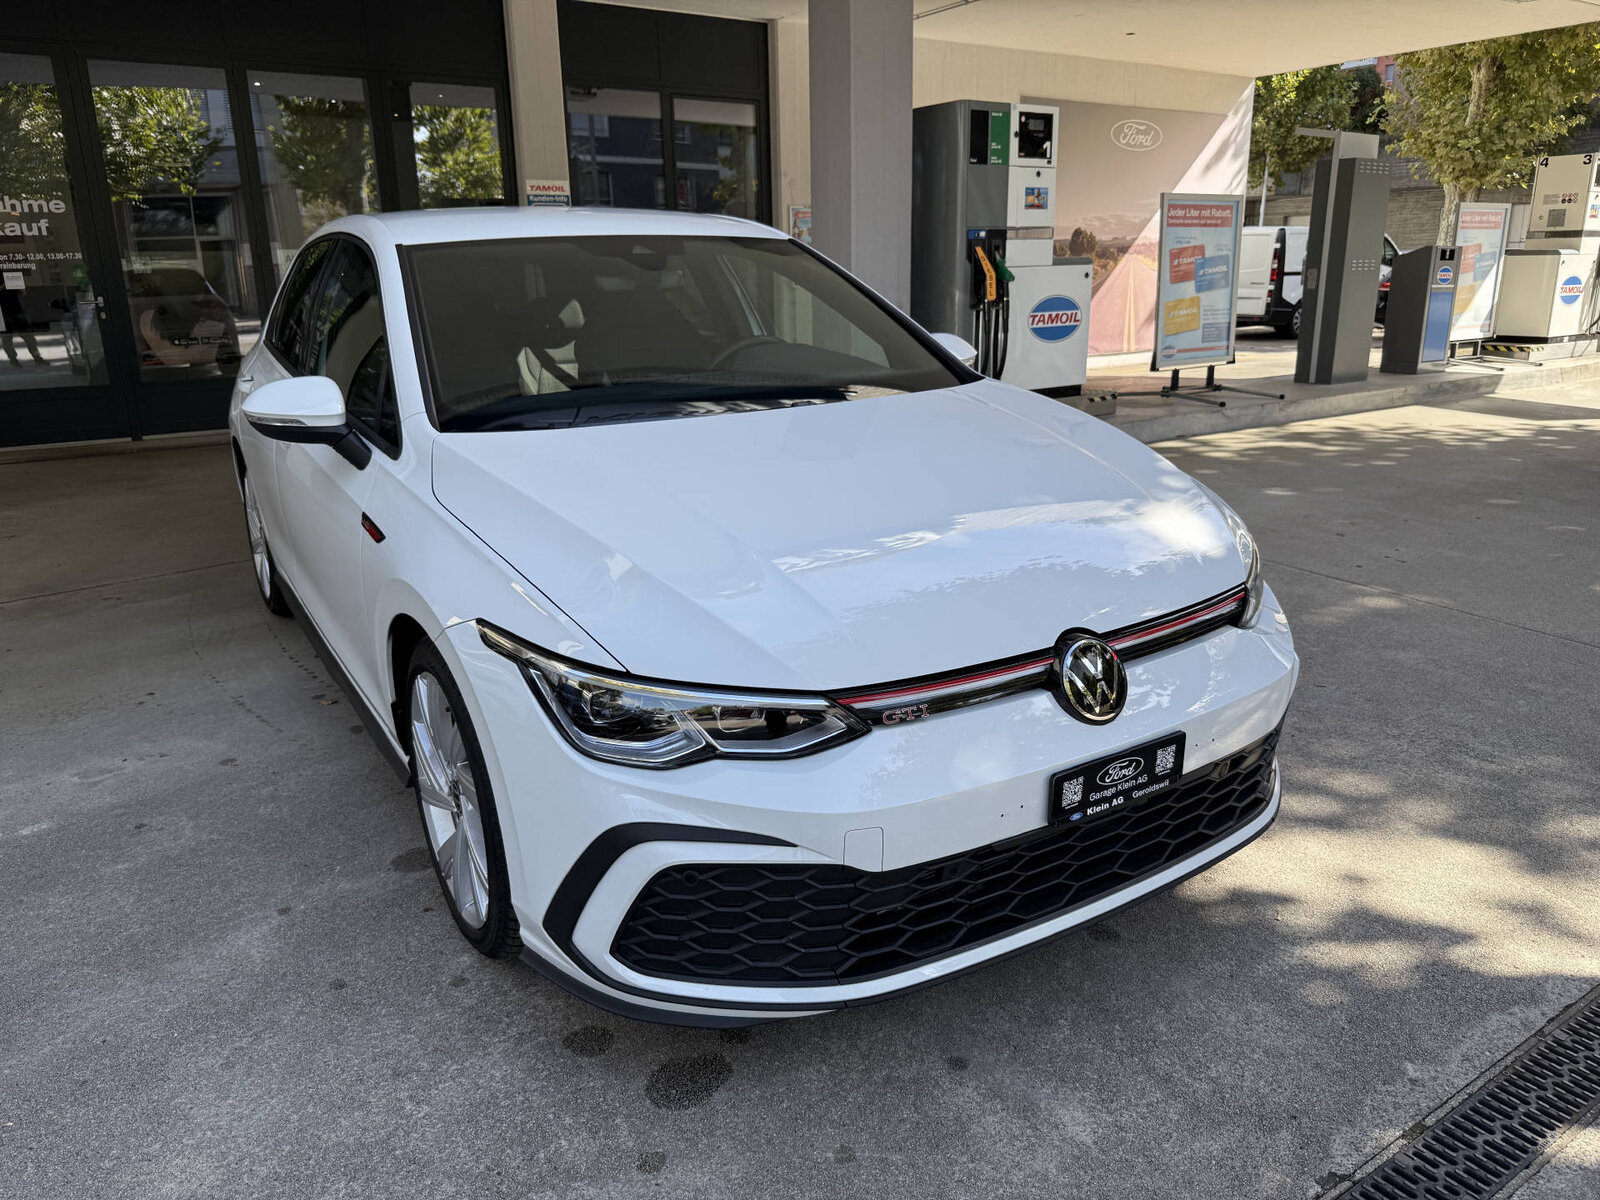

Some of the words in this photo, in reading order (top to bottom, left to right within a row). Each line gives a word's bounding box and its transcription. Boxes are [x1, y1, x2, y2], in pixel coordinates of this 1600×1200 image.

[1120, 123, 1154, 146] Ford
[1043, 141, 1051, 158] 1
[1540, 157, 1549, 167] 4
[1583, 154, 1592, 165] 3
[1168, 208, 1185, 217] Jeder
[1186, 208, 1200, 217] Liter
[1201, 208, 1210, 217] mit
[1560, 286, 1583, 294] TAMOIL
[1030, 312, 1081, 326] TAMOIL
[882, 704, 930, 725] GTI
[1105, 761, 1136, 782] Ford
[1089, 786, 1117, 802] Garage
[1117, 780, 1136, 792] Klein
[1136, 774, 1148, 784] AG
[1087, 802, 1110, 815] Klein
[1111, 796, 1124, 806] AG
[1132, 779, 1170, 798] Geroldswil
